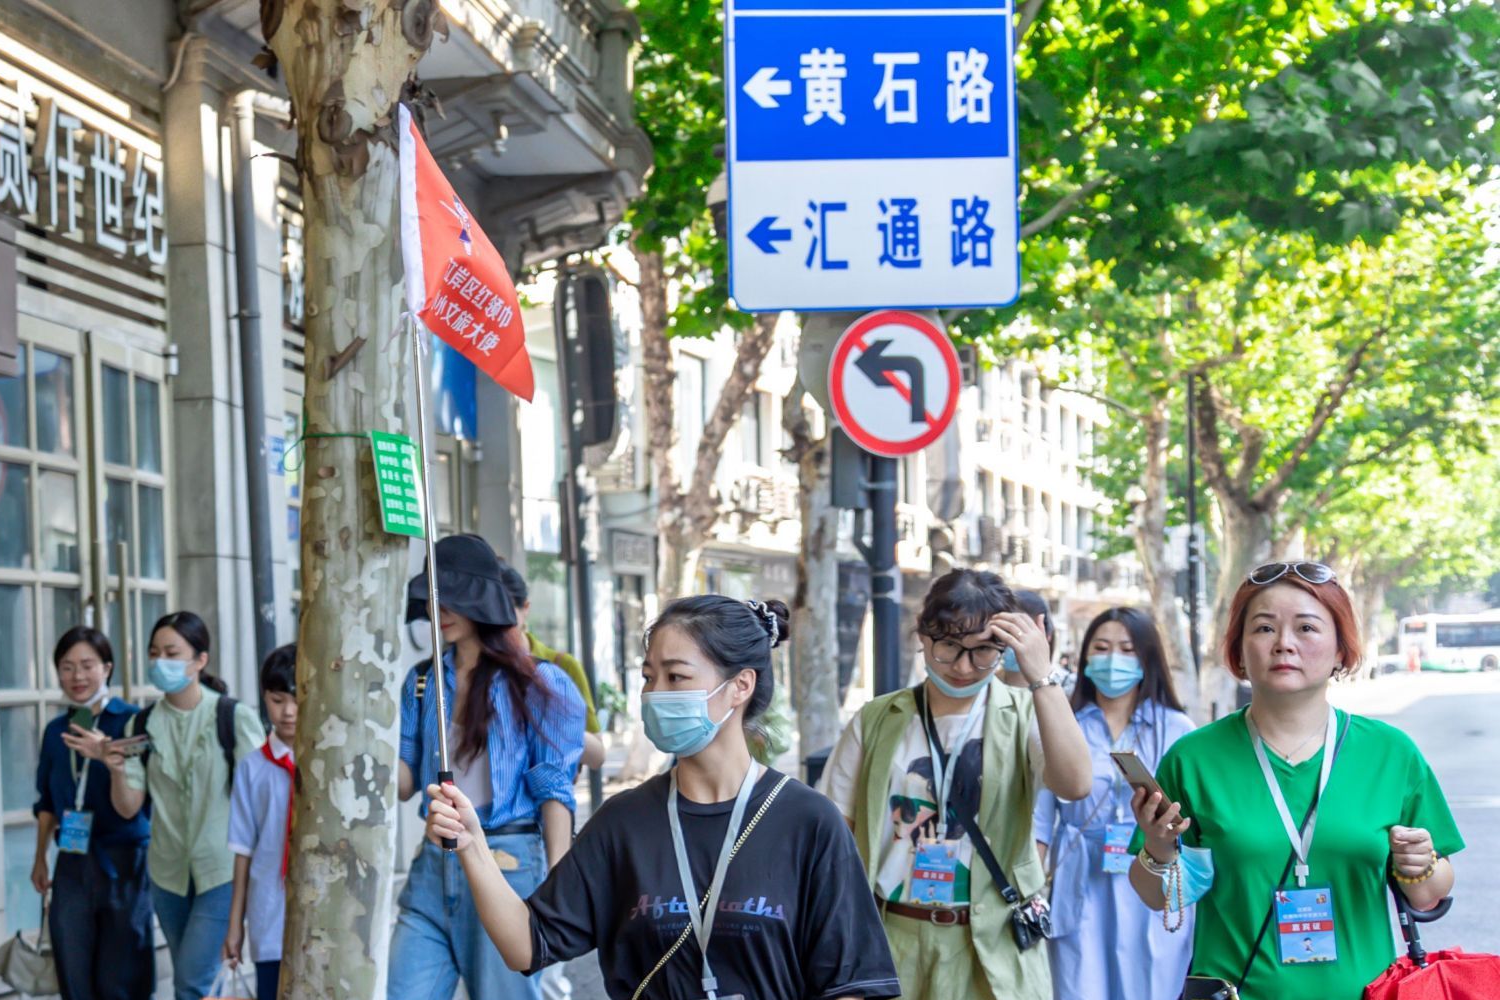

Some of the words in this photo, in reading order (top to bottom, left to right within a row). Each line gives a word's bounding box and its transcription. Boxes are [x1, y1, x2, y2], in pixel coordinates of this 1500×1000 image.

[799, 47, 994, 126] 黄石路
[803, 194, 995, 270] 汇通路
